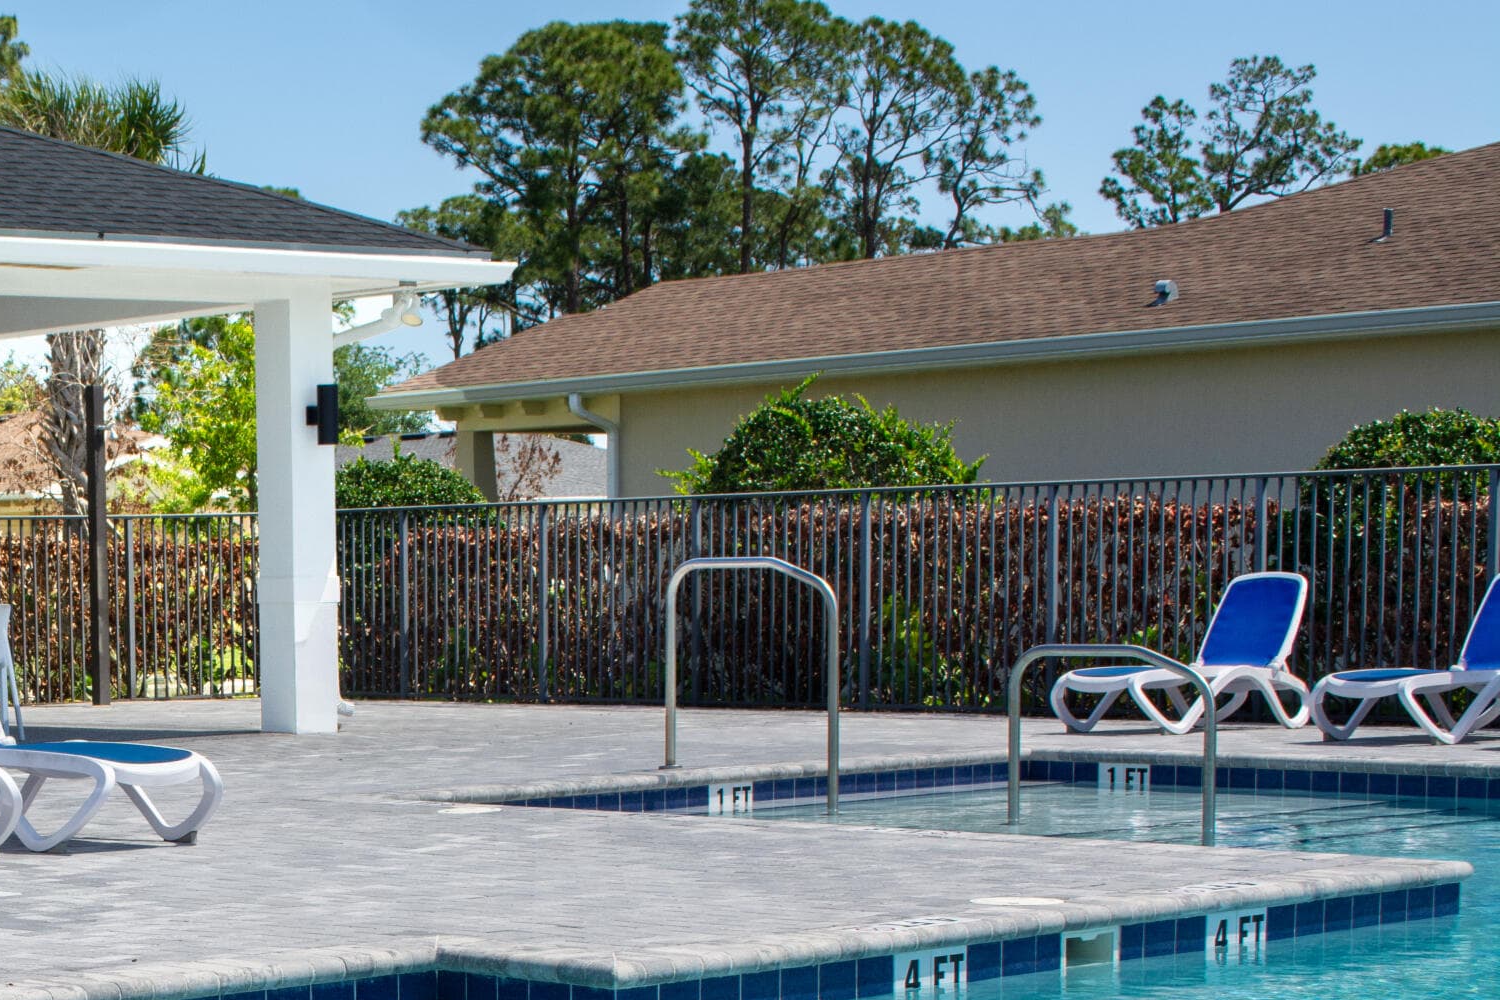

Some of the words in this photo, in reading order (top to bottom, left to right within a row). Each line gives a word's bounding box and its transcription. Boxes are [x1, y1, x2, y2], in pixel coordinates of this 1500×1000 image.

[1125, 767, 1148, 784] FT
[733, 786, 751, 804] FT
[1215, 919, 1228, 946] 4
[1239, 914, 1264, 944] FT
[904, 959, 921, 988] 4
[934, 953, 964, 986] FT
